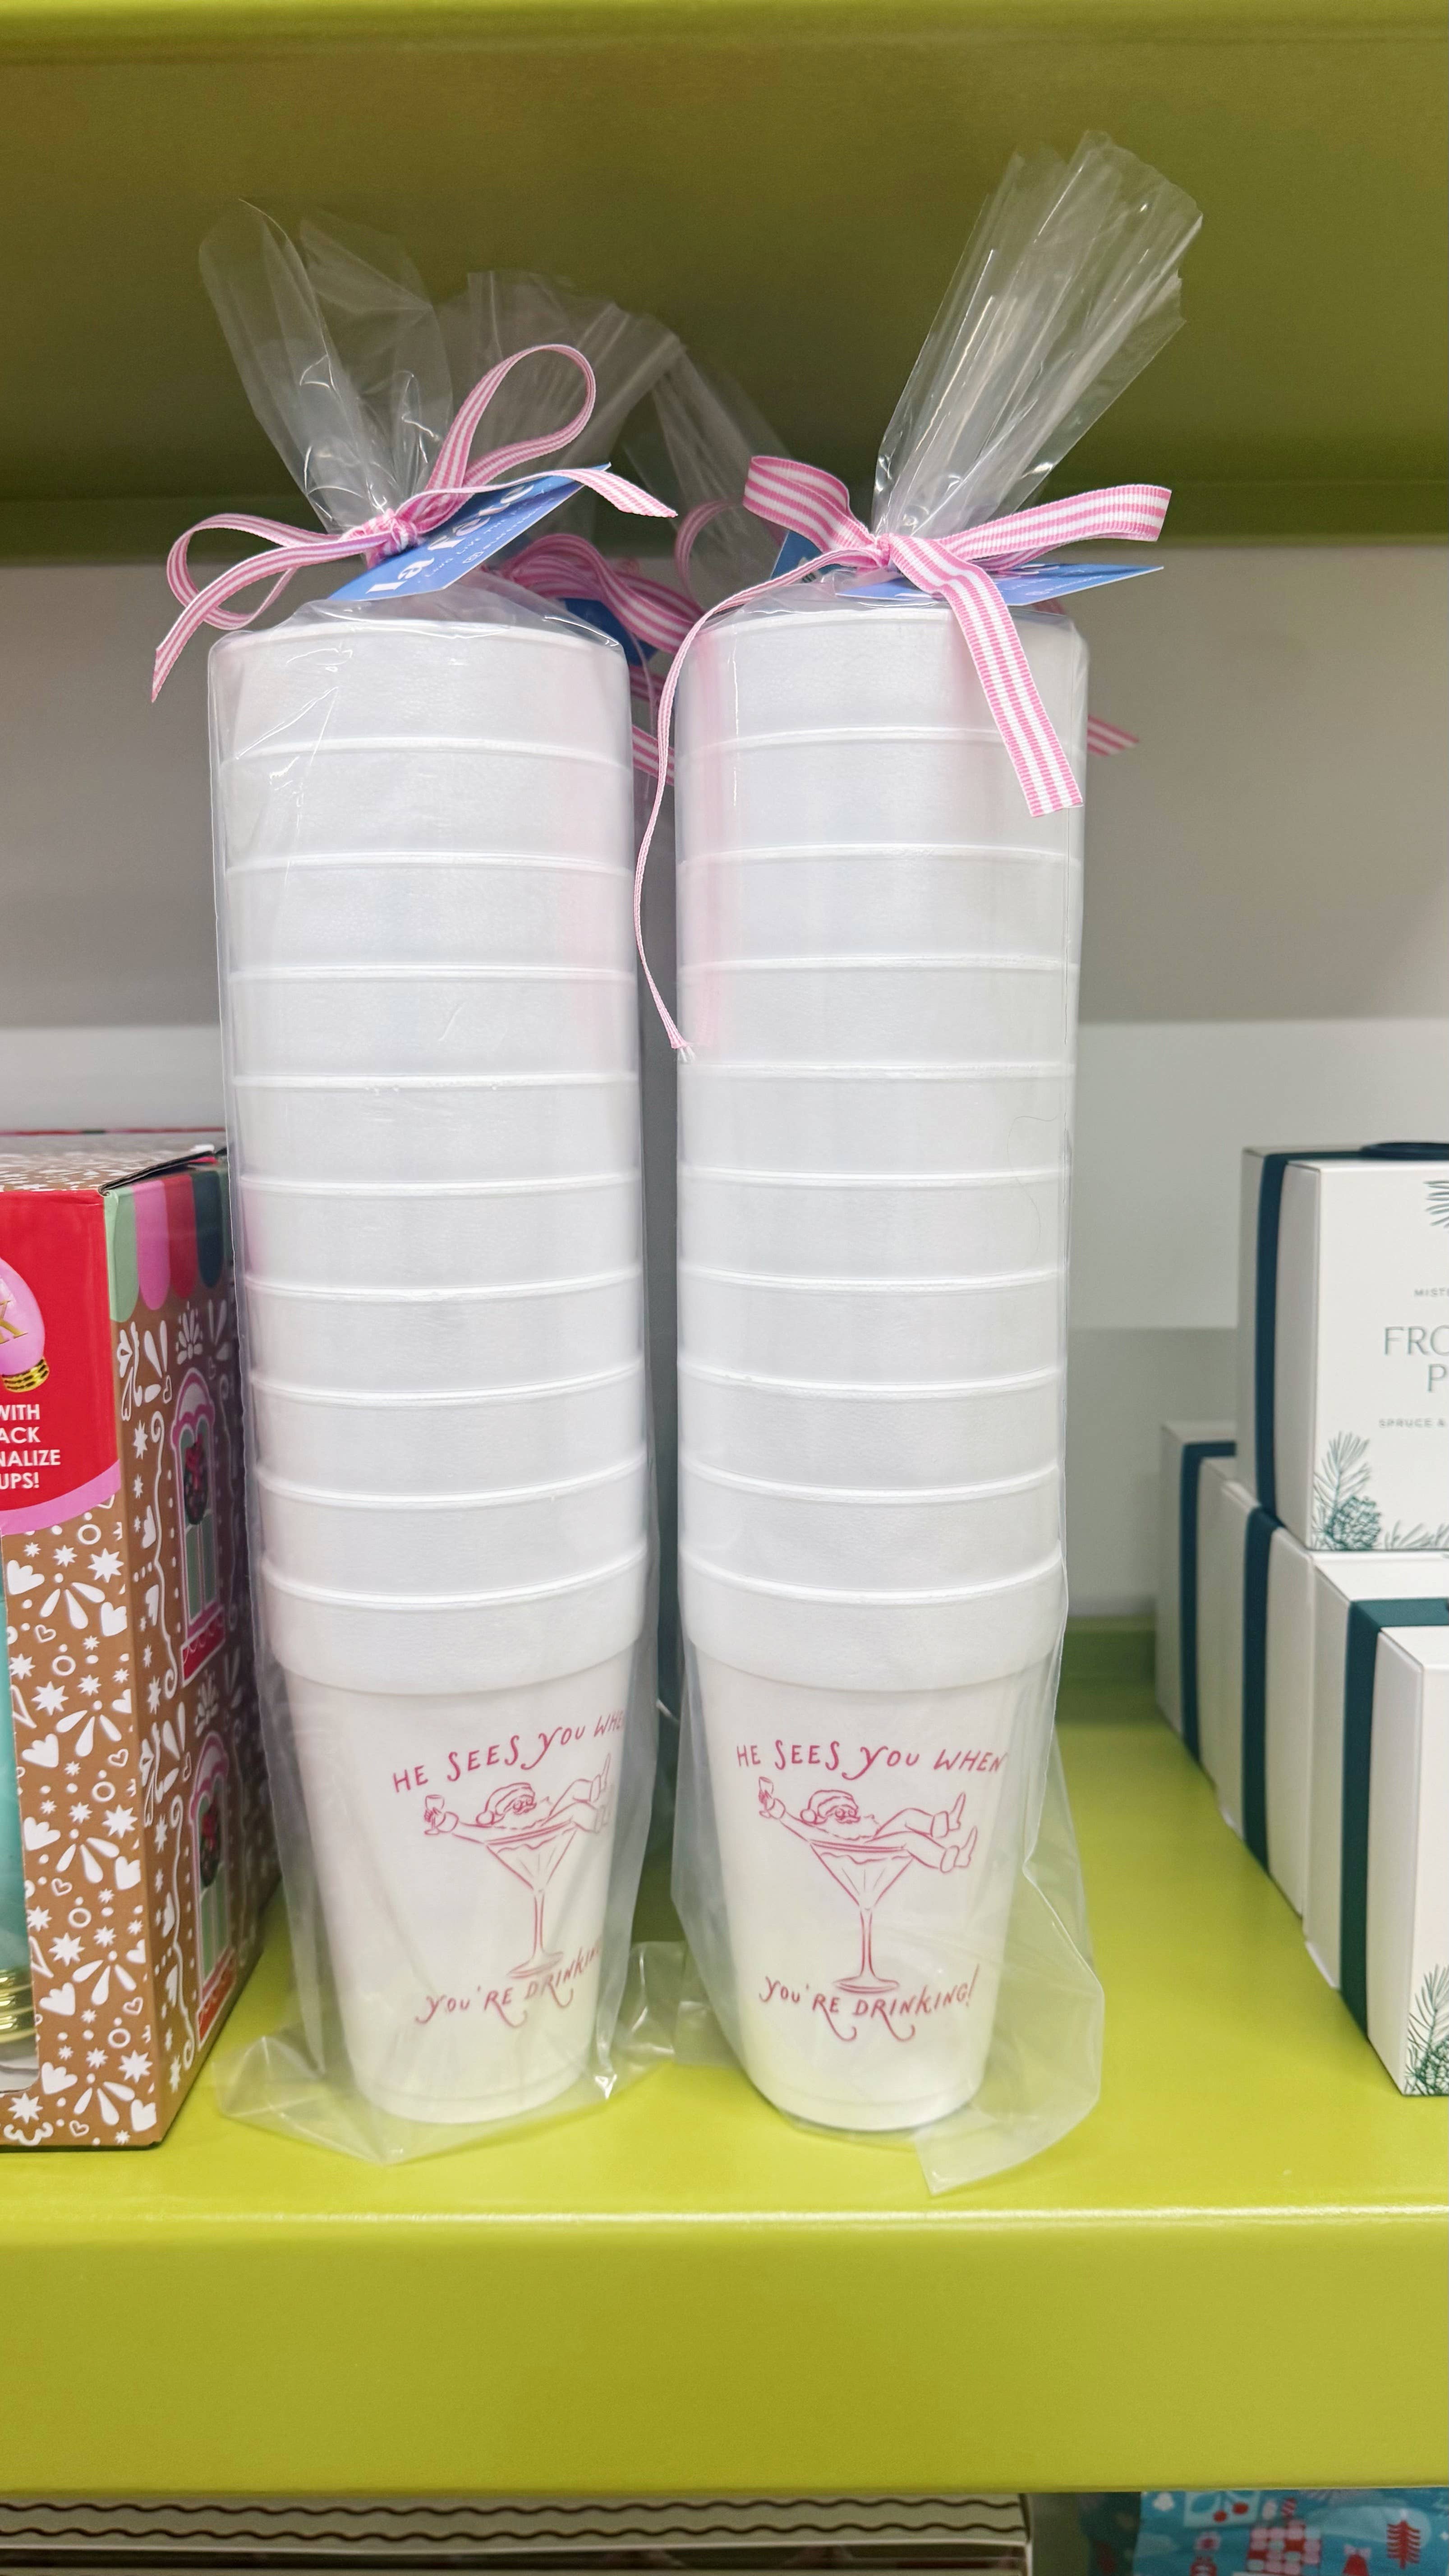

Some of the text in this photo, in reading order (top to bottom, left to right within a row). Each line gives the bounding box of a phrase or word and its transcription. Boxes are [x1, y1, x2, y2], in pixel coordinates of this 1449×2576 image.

[365, 557, 435, 595] la
[1379, 1418, 1434, 1428] SPRUCE
[393, 1765, 429, 1794] HE
[447, 1735, 520, 1782] SEES
[521, 1725, 586, 1771] YOU
[736, 1739, 1008, 1780] HE SEES YOU WHEN
[415, 1985, 528, 2029] YOU'RE
[759, 1963, 980, 2042] YOU'RE DRINKING!
